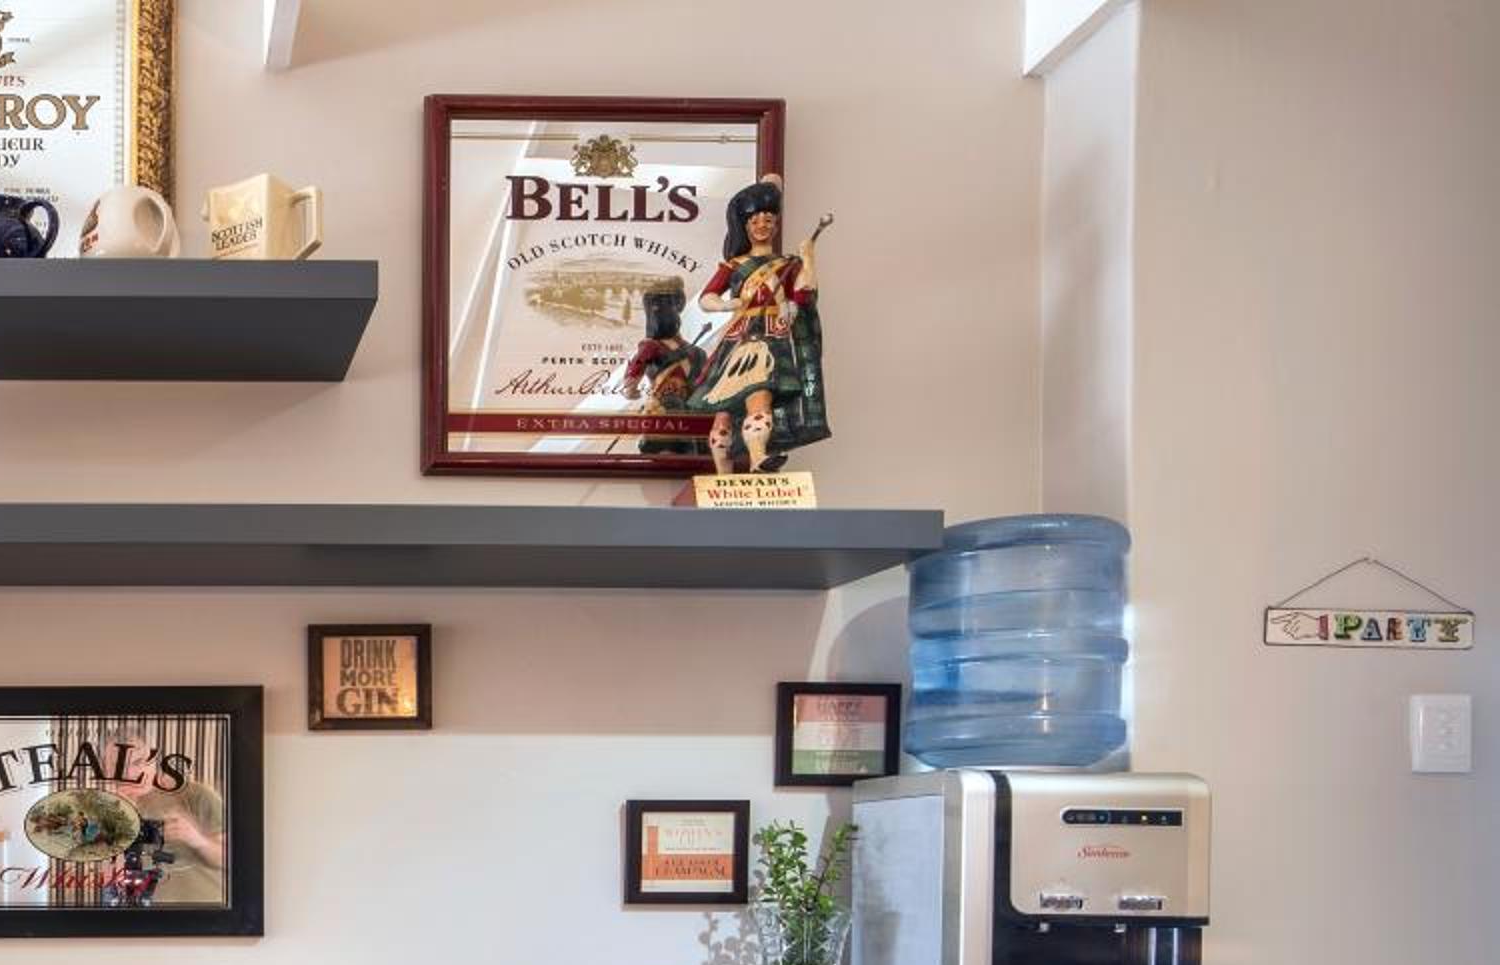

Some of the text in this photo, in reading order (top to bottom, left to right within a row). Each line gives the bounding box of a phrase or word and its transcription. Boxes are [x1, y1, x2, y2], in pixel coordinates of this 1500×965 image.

[505, 174, 700, 223] BELL'S
[507, 233, 703, 274] OLD SCOTCH WHISKY
[516, 417, 690, 432] EXTRA SPECIAL
[1333, 613, 1468, 643] PARTY
[340, 639, 397, 669] DRINK
[340, 669, 397, 687] MORE
[336, 687, 400, 715] GIN
